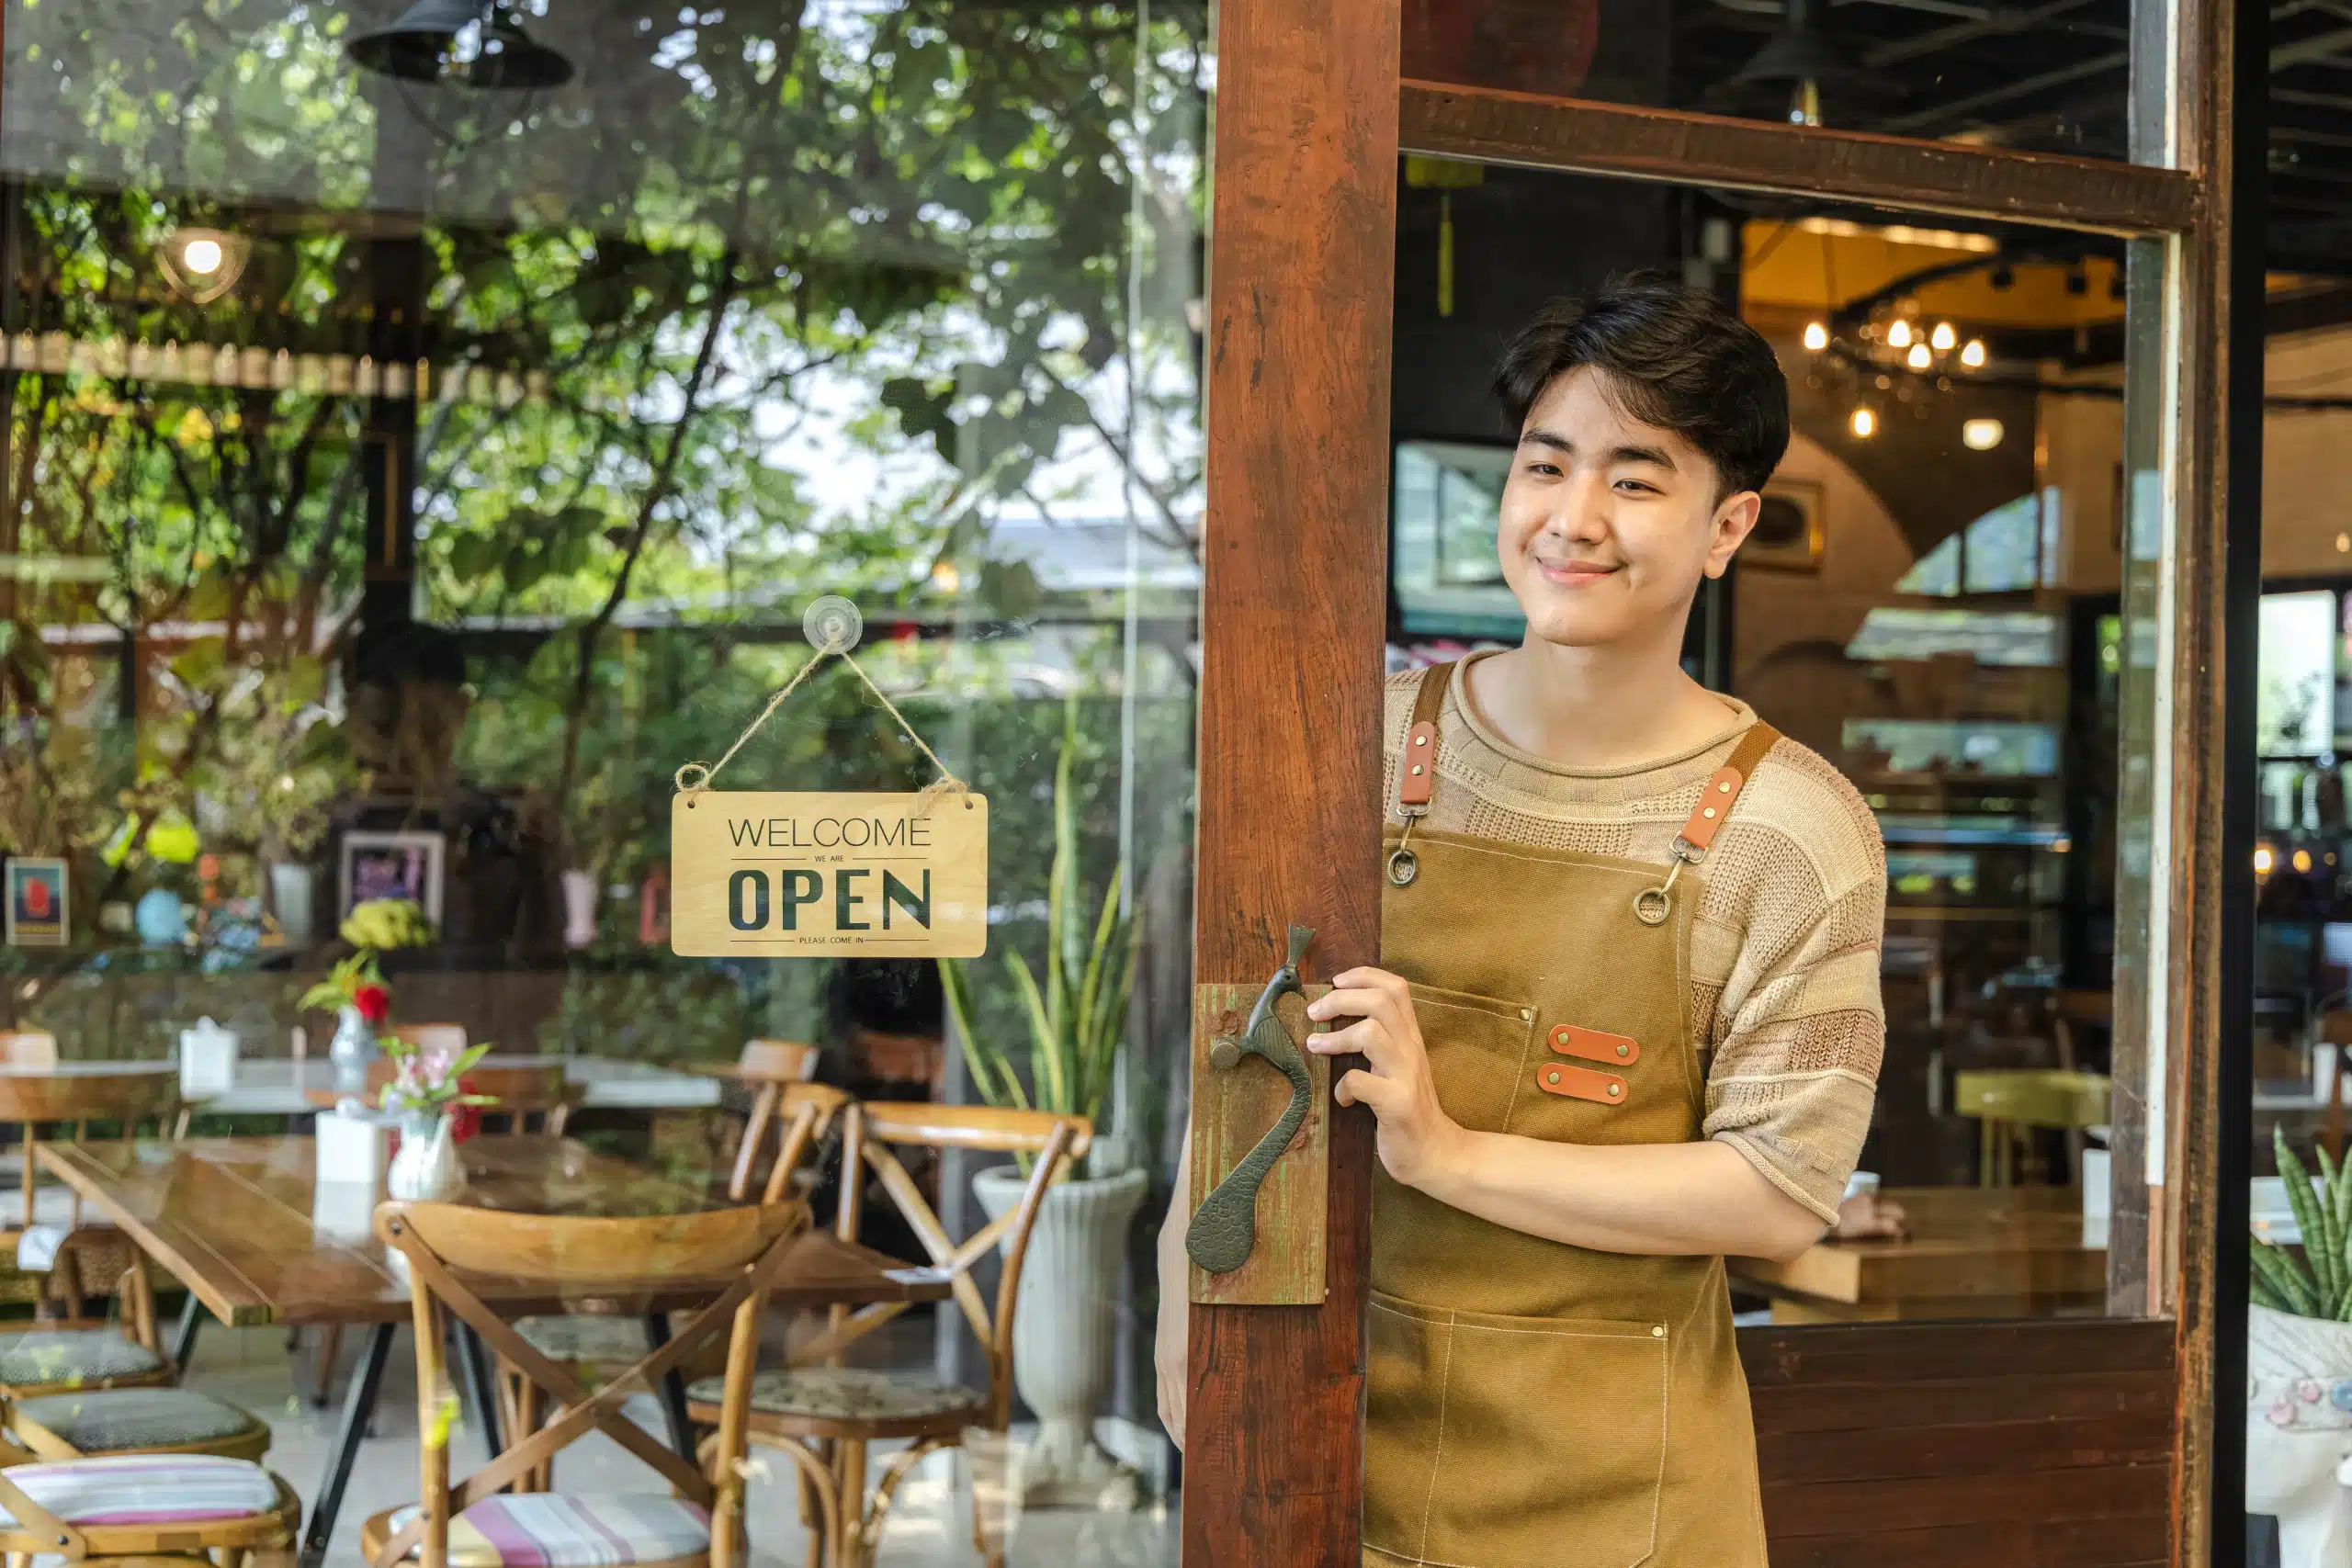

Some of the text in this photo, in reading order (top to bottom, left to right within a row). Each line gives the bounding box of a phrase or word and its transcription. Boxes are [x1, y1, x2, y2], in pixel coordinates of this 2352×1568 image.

[728, 818, 932, 847] WELCOME
[729, 868, 931, 931] OPEN
[799, 936, 864, 944] PLEASE COME IN
